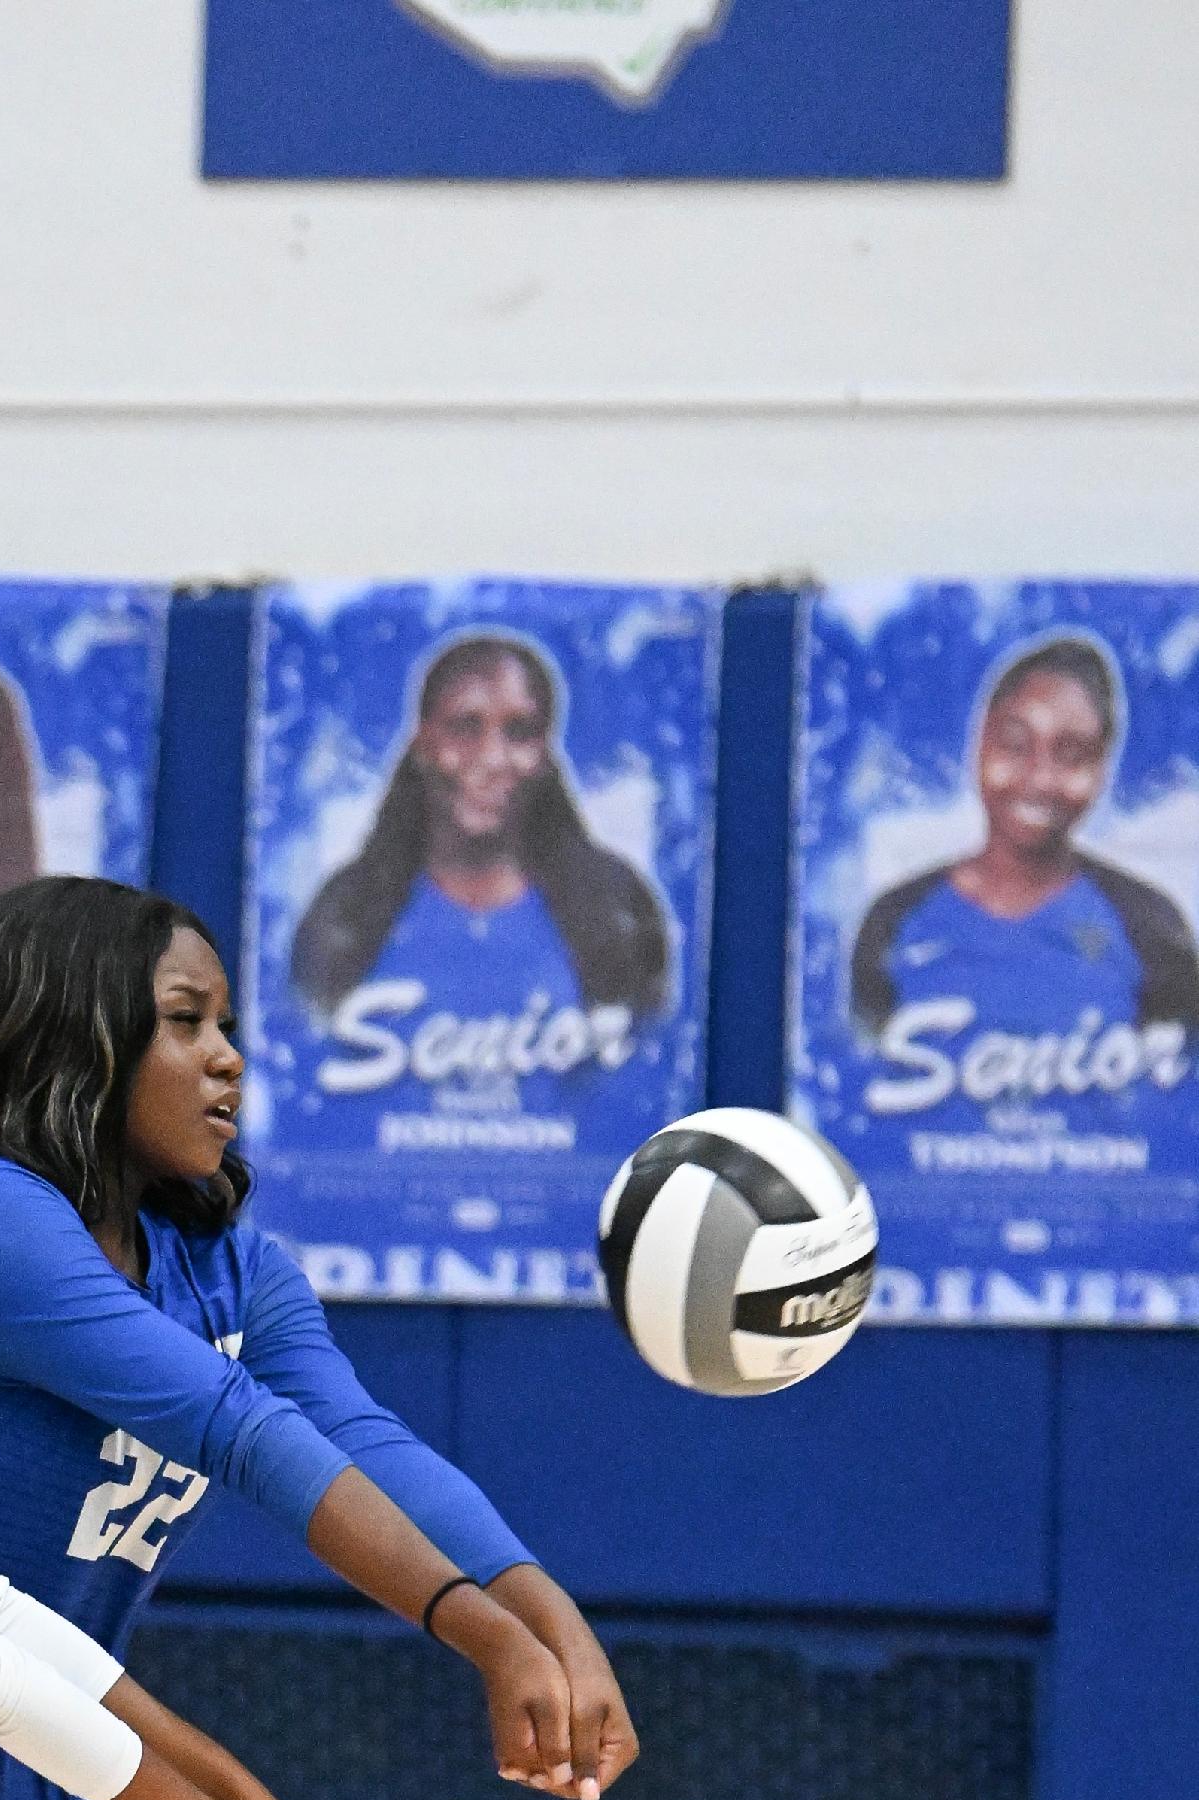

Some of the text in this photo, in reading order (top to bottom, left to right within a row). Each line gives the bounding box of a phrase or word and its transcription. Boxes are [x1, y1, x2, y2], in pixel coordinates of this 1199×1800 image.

[317, 978, 636, 1094] Senior
[864, 996, 1192, 1114] Senior
[66, 1427, 210, 1572] 22
